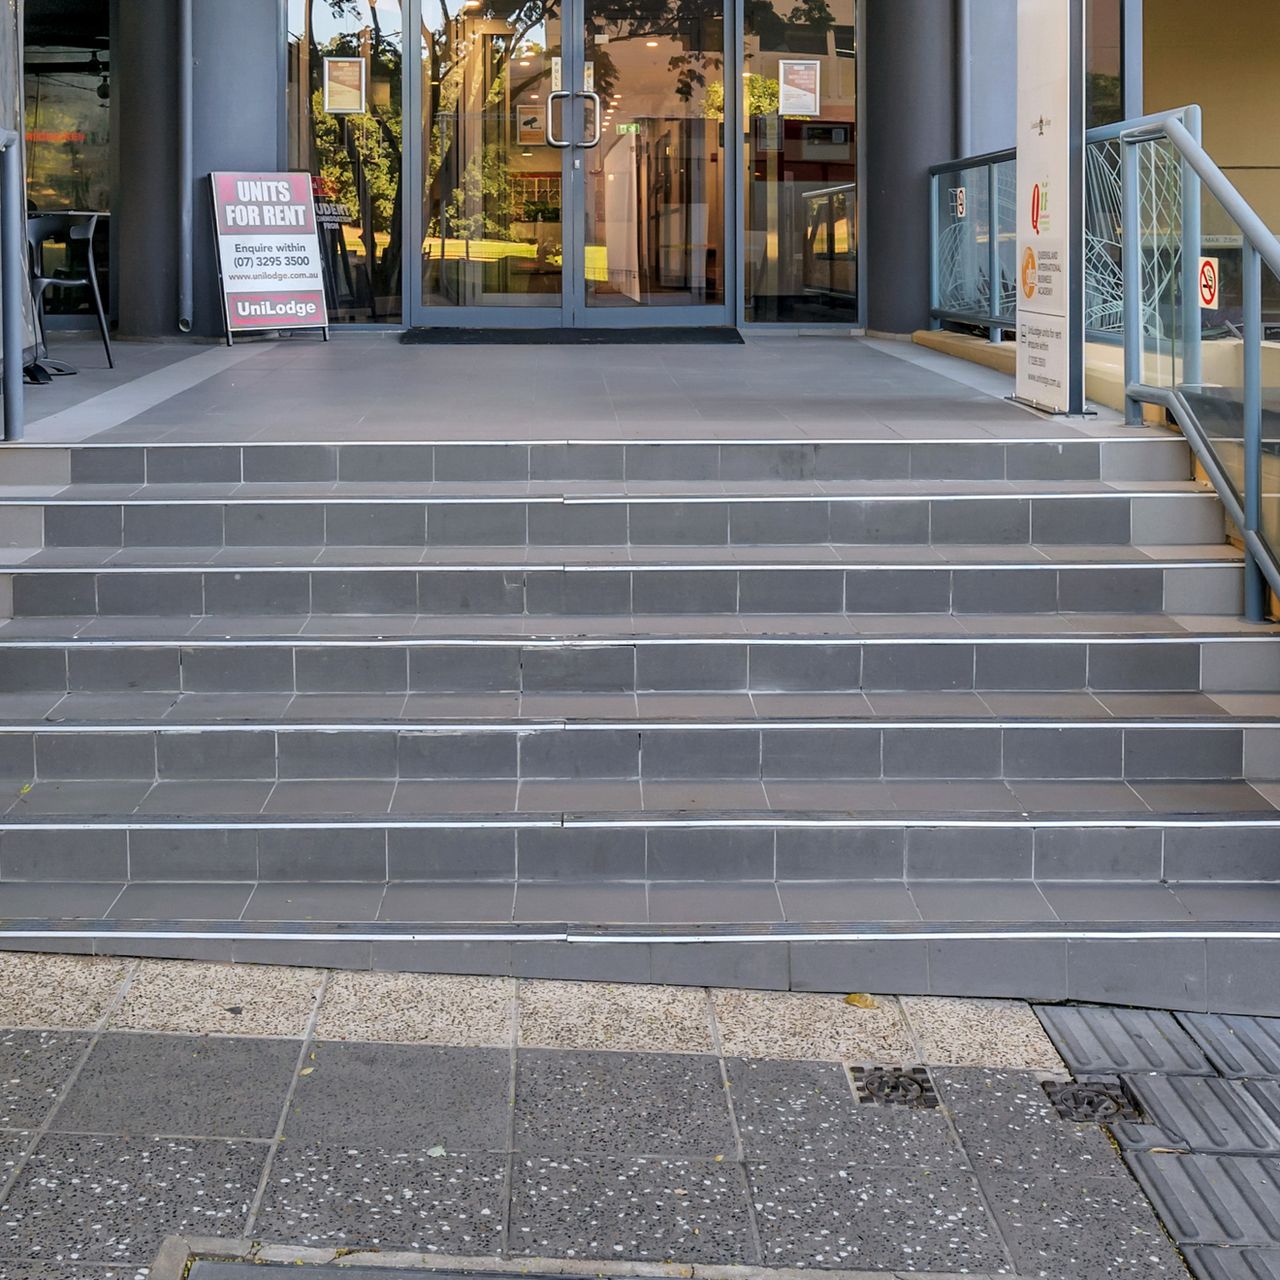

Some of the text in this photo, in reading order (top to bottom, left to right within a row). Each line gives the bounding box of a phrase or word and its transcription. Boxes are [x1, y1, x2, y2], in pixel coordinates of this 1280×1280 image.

[237, 181, 291, 202] UNITS
[225, 205, 306, 226] FOR RENT
[234, 242, 306, 255] Enquire within
[233, 255, 310, 269] (07) 3295 3500
[228, 271, 318, 281] www.unilodge.com.au
[237, 301, 316, 317] UniLodge
